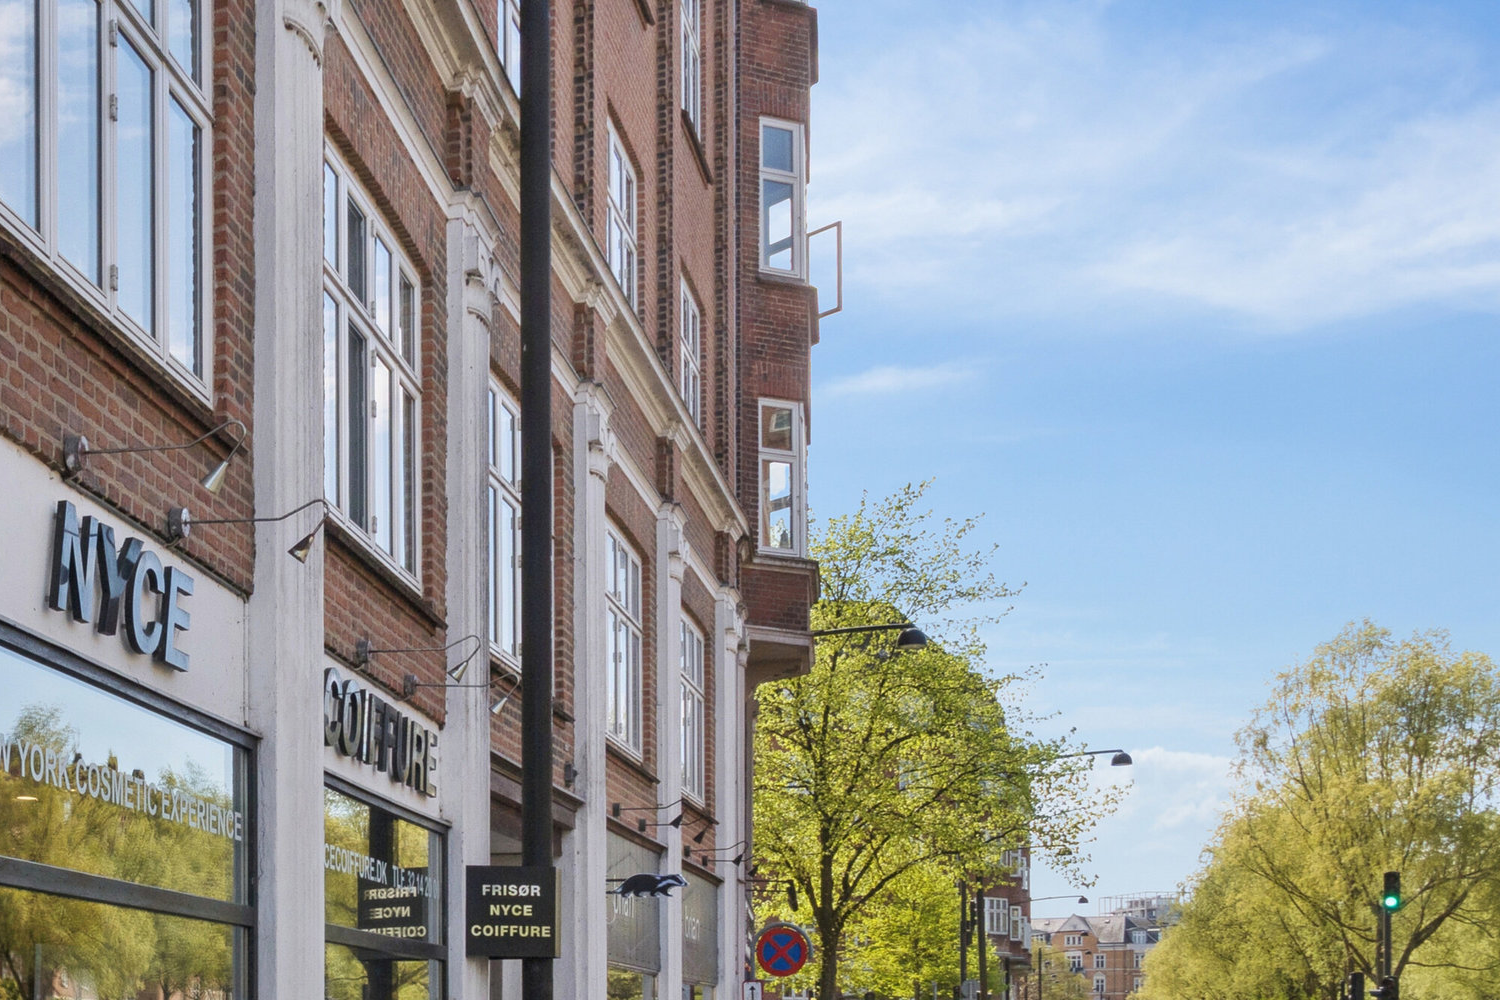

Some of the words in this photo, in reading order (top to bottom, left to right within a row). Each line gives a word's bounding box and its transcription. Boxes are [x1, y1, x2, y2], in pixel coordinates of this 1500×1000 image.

[49, 500, 194, 673] NYCE
[324, 667, 437, 799] COIFFURE
[17, 739, 70, 791] YORK
[75, 757, 157, 816] COSMETIC
[161, 785, 242, 842] EXPERIENCE
[482, 884, 541, 897] FRISØR
[490, 904, 533, 917] NYCE
[471, 924, 552, 938] COIFFURE
